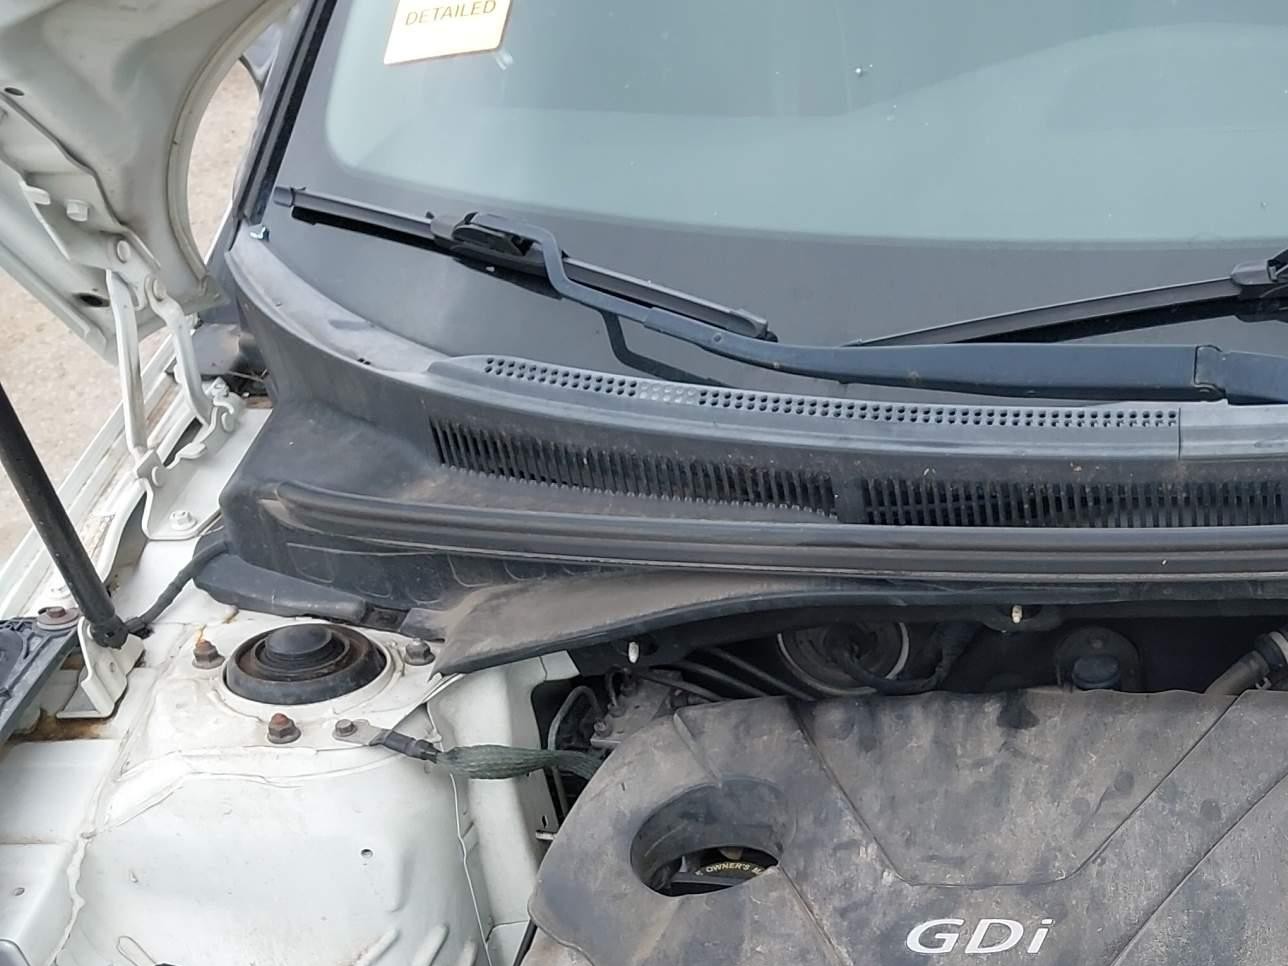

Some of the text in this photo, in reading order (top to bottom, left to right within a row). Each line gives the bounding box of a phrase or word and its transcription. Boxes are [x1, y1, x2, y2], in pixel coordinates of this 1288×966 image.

[405, 0, 496, 26] DETAILED
[705, 862, 751, 873] OWNER'S
[906, 918, 1053, 954] GDi
